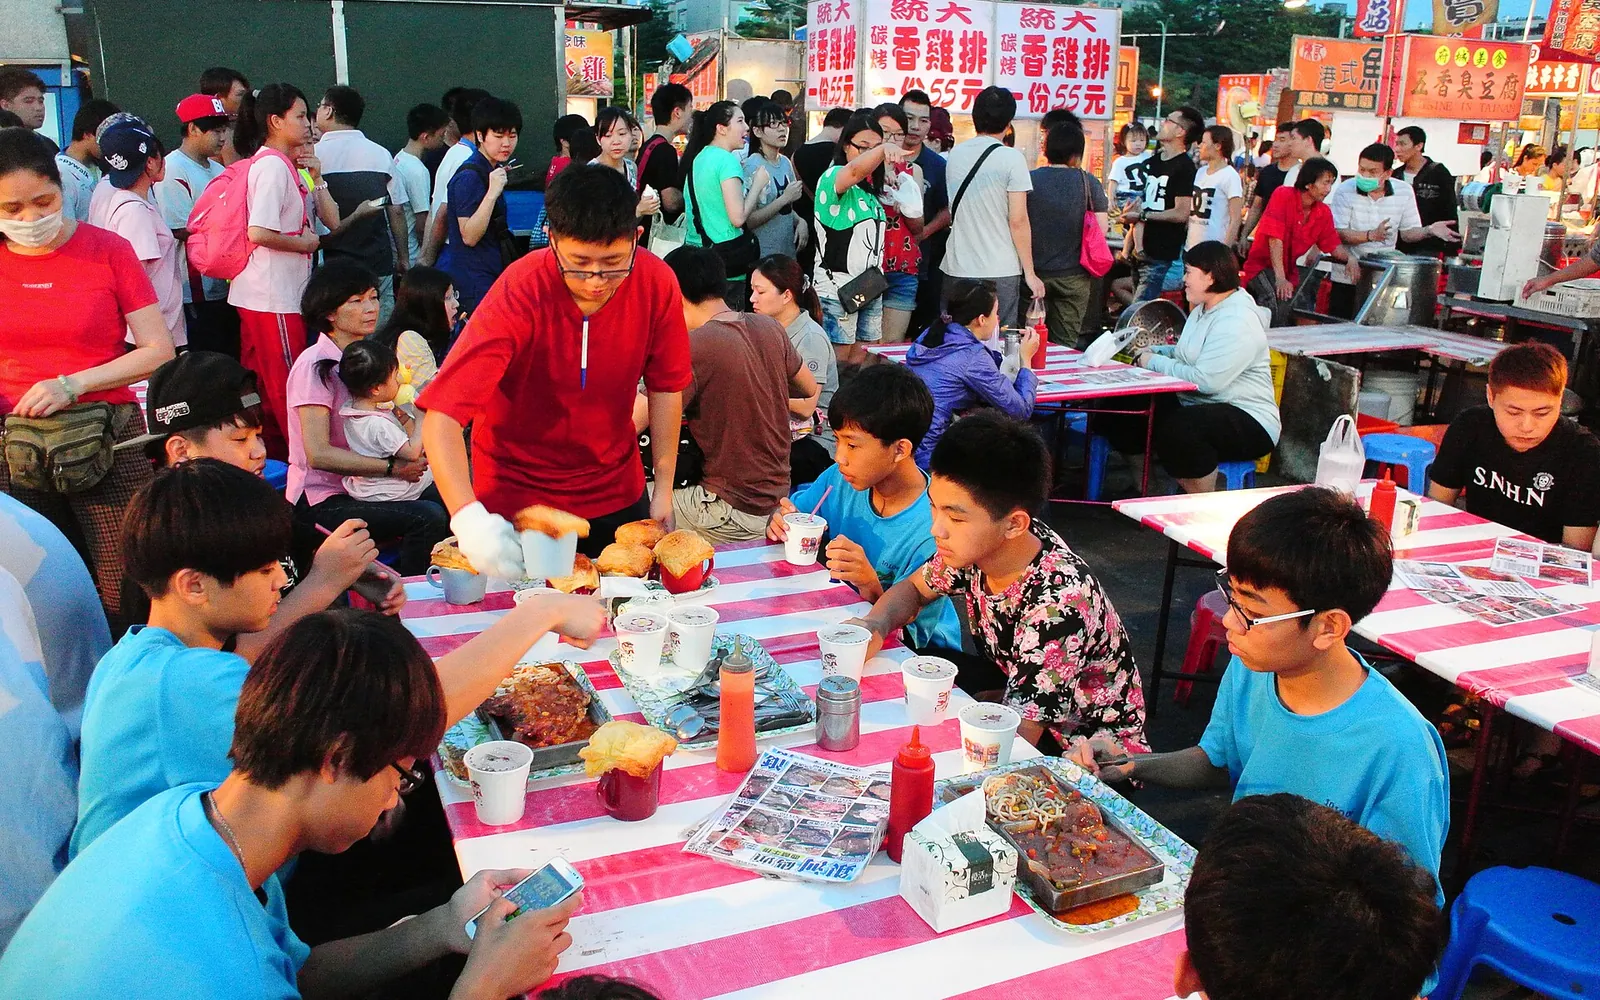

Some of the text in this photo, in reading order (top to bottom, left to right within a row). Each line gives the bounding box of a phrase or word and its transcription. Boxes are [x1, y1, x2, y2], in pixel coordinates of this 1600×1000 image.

[817, 25, 856, 72] 香雞排
[870, 25, 888, 70] 碳烤
[892, 27, 987, 74] 香雞排
[1000, 33, 1017, 76] 碳烤
[1021, 35, 1110, 80] 香雞排
[809, 75, 853, 107] 一份55元
[1411, 69, 1520, 101] 五香臭豆腐
